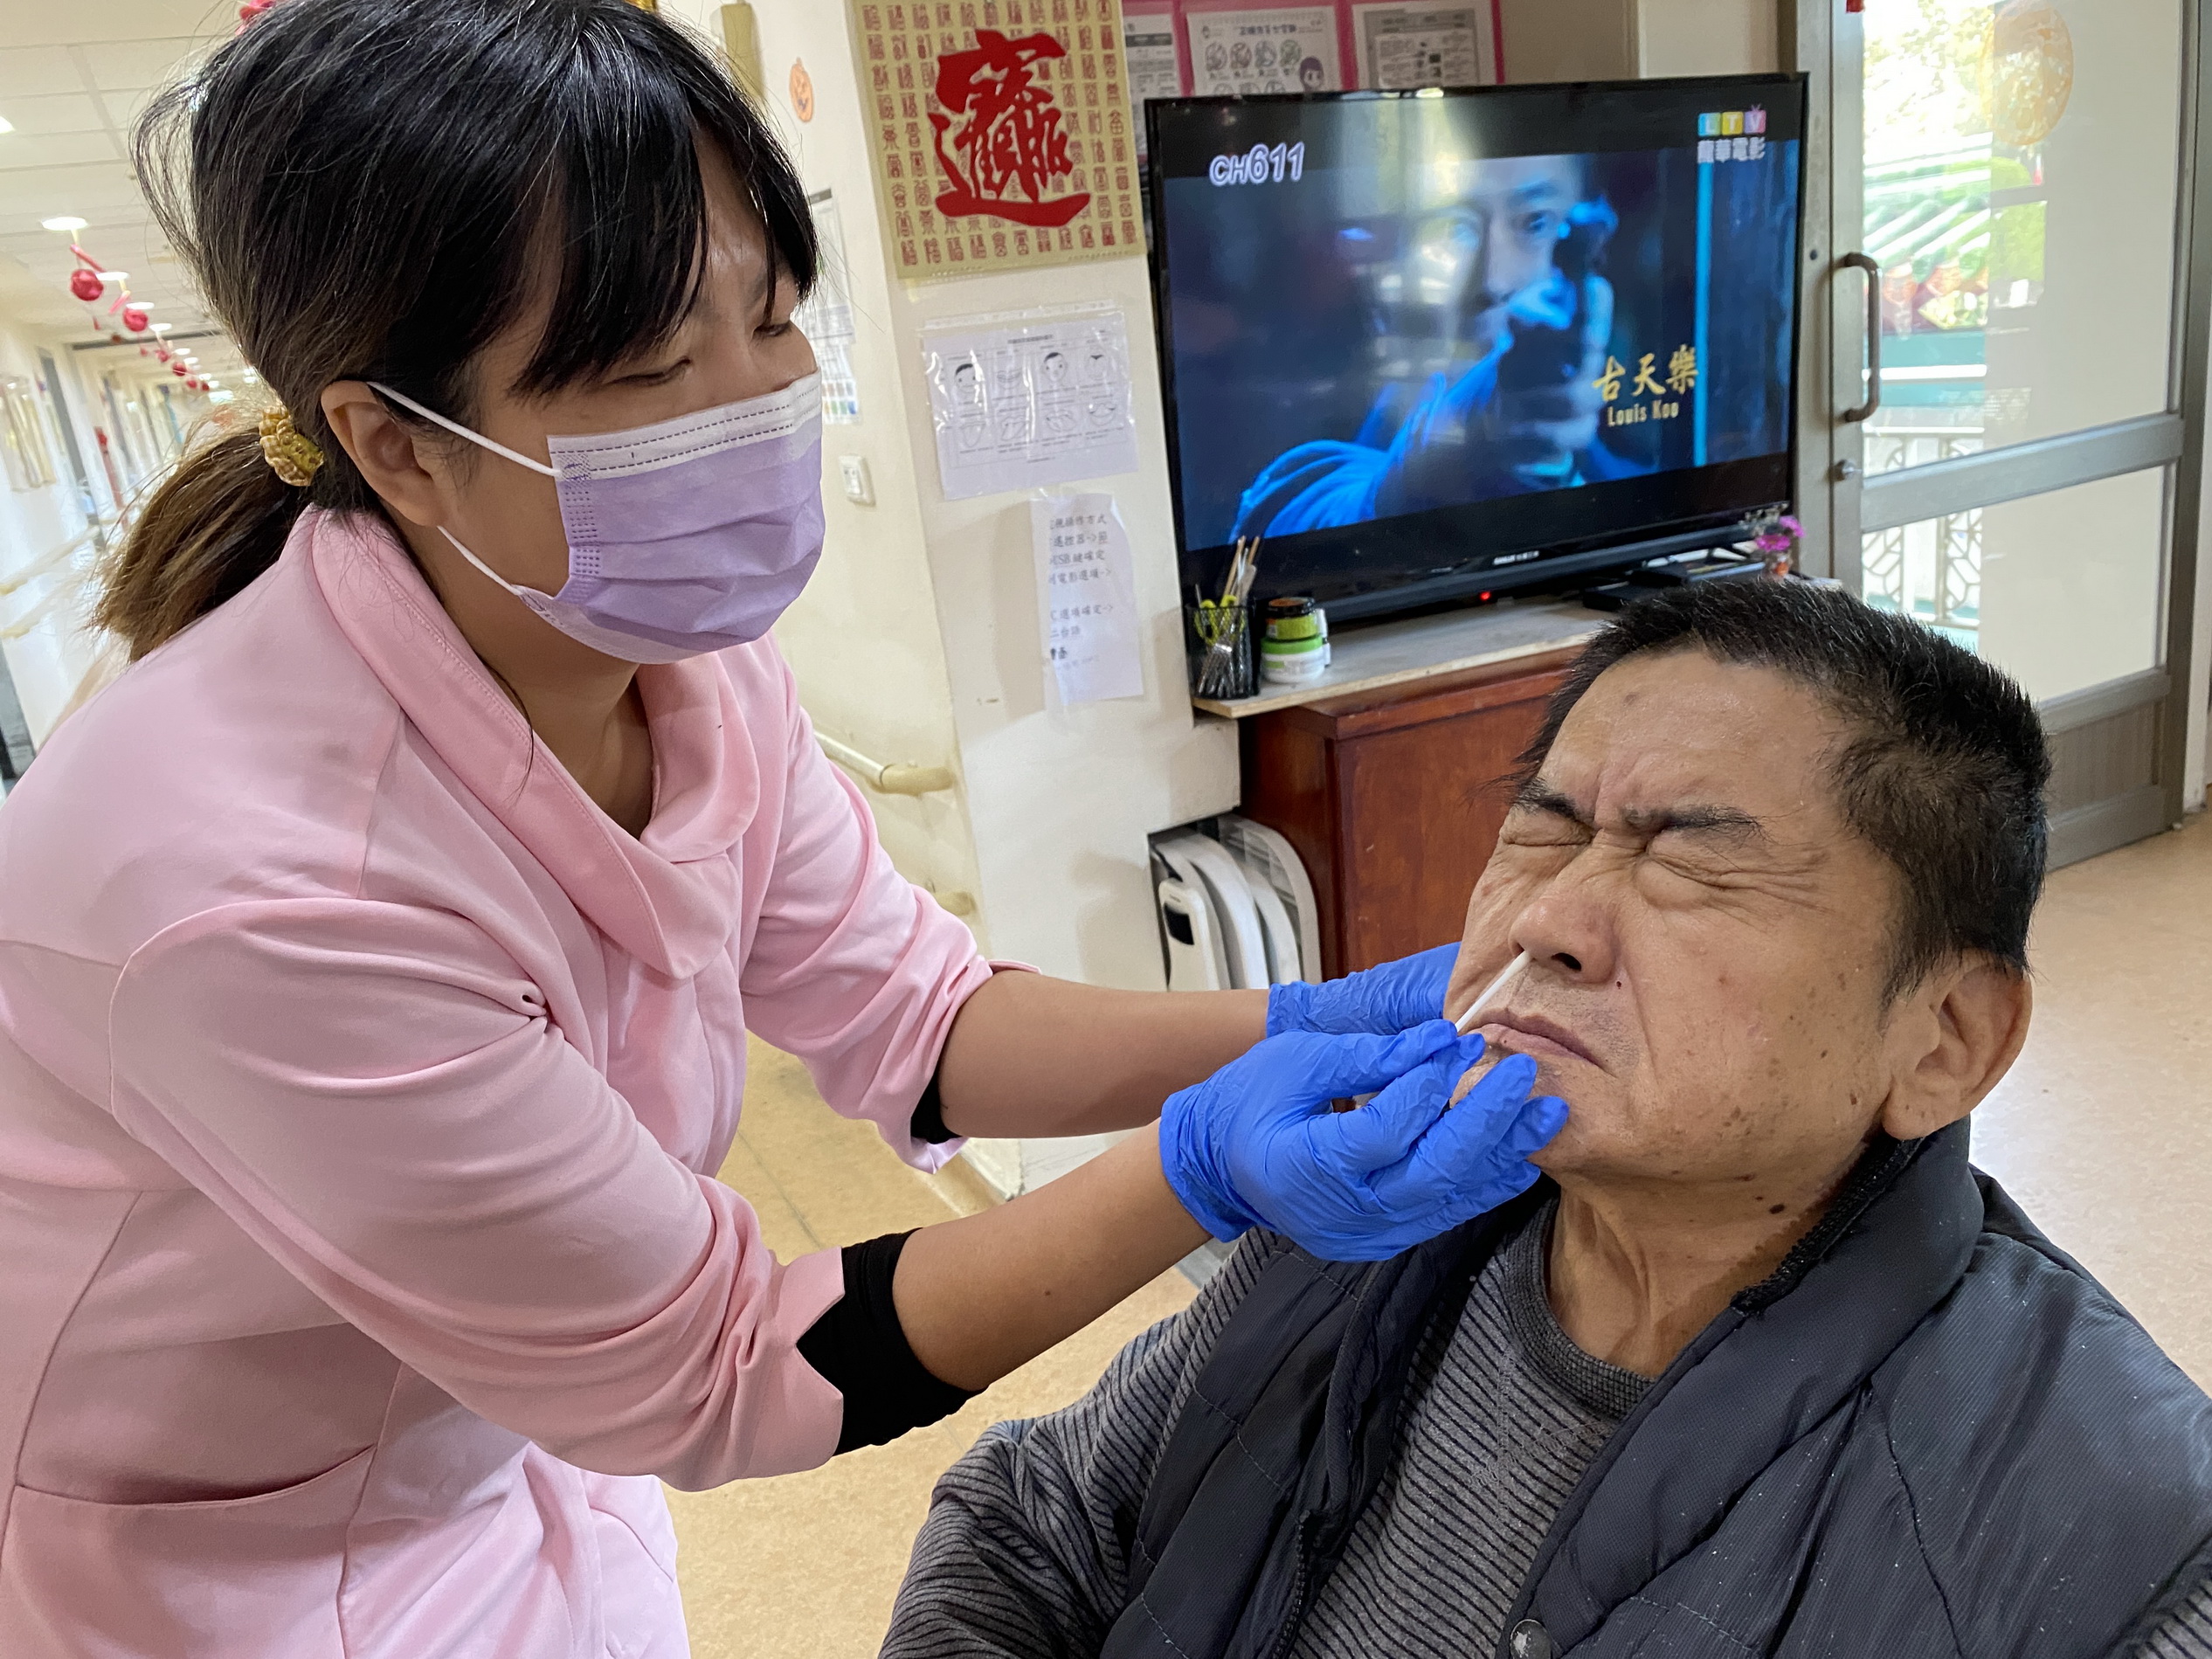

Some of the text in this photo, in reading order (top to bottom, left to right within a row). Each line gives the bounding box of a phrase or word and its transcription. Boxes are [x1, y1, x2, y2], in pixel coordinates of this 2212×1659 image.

[1209, 141, 1305, 186] CH611
[1592, 344, 1698, 402] 古天樂
[1607, 400, 1679, 426] Louis Koo
